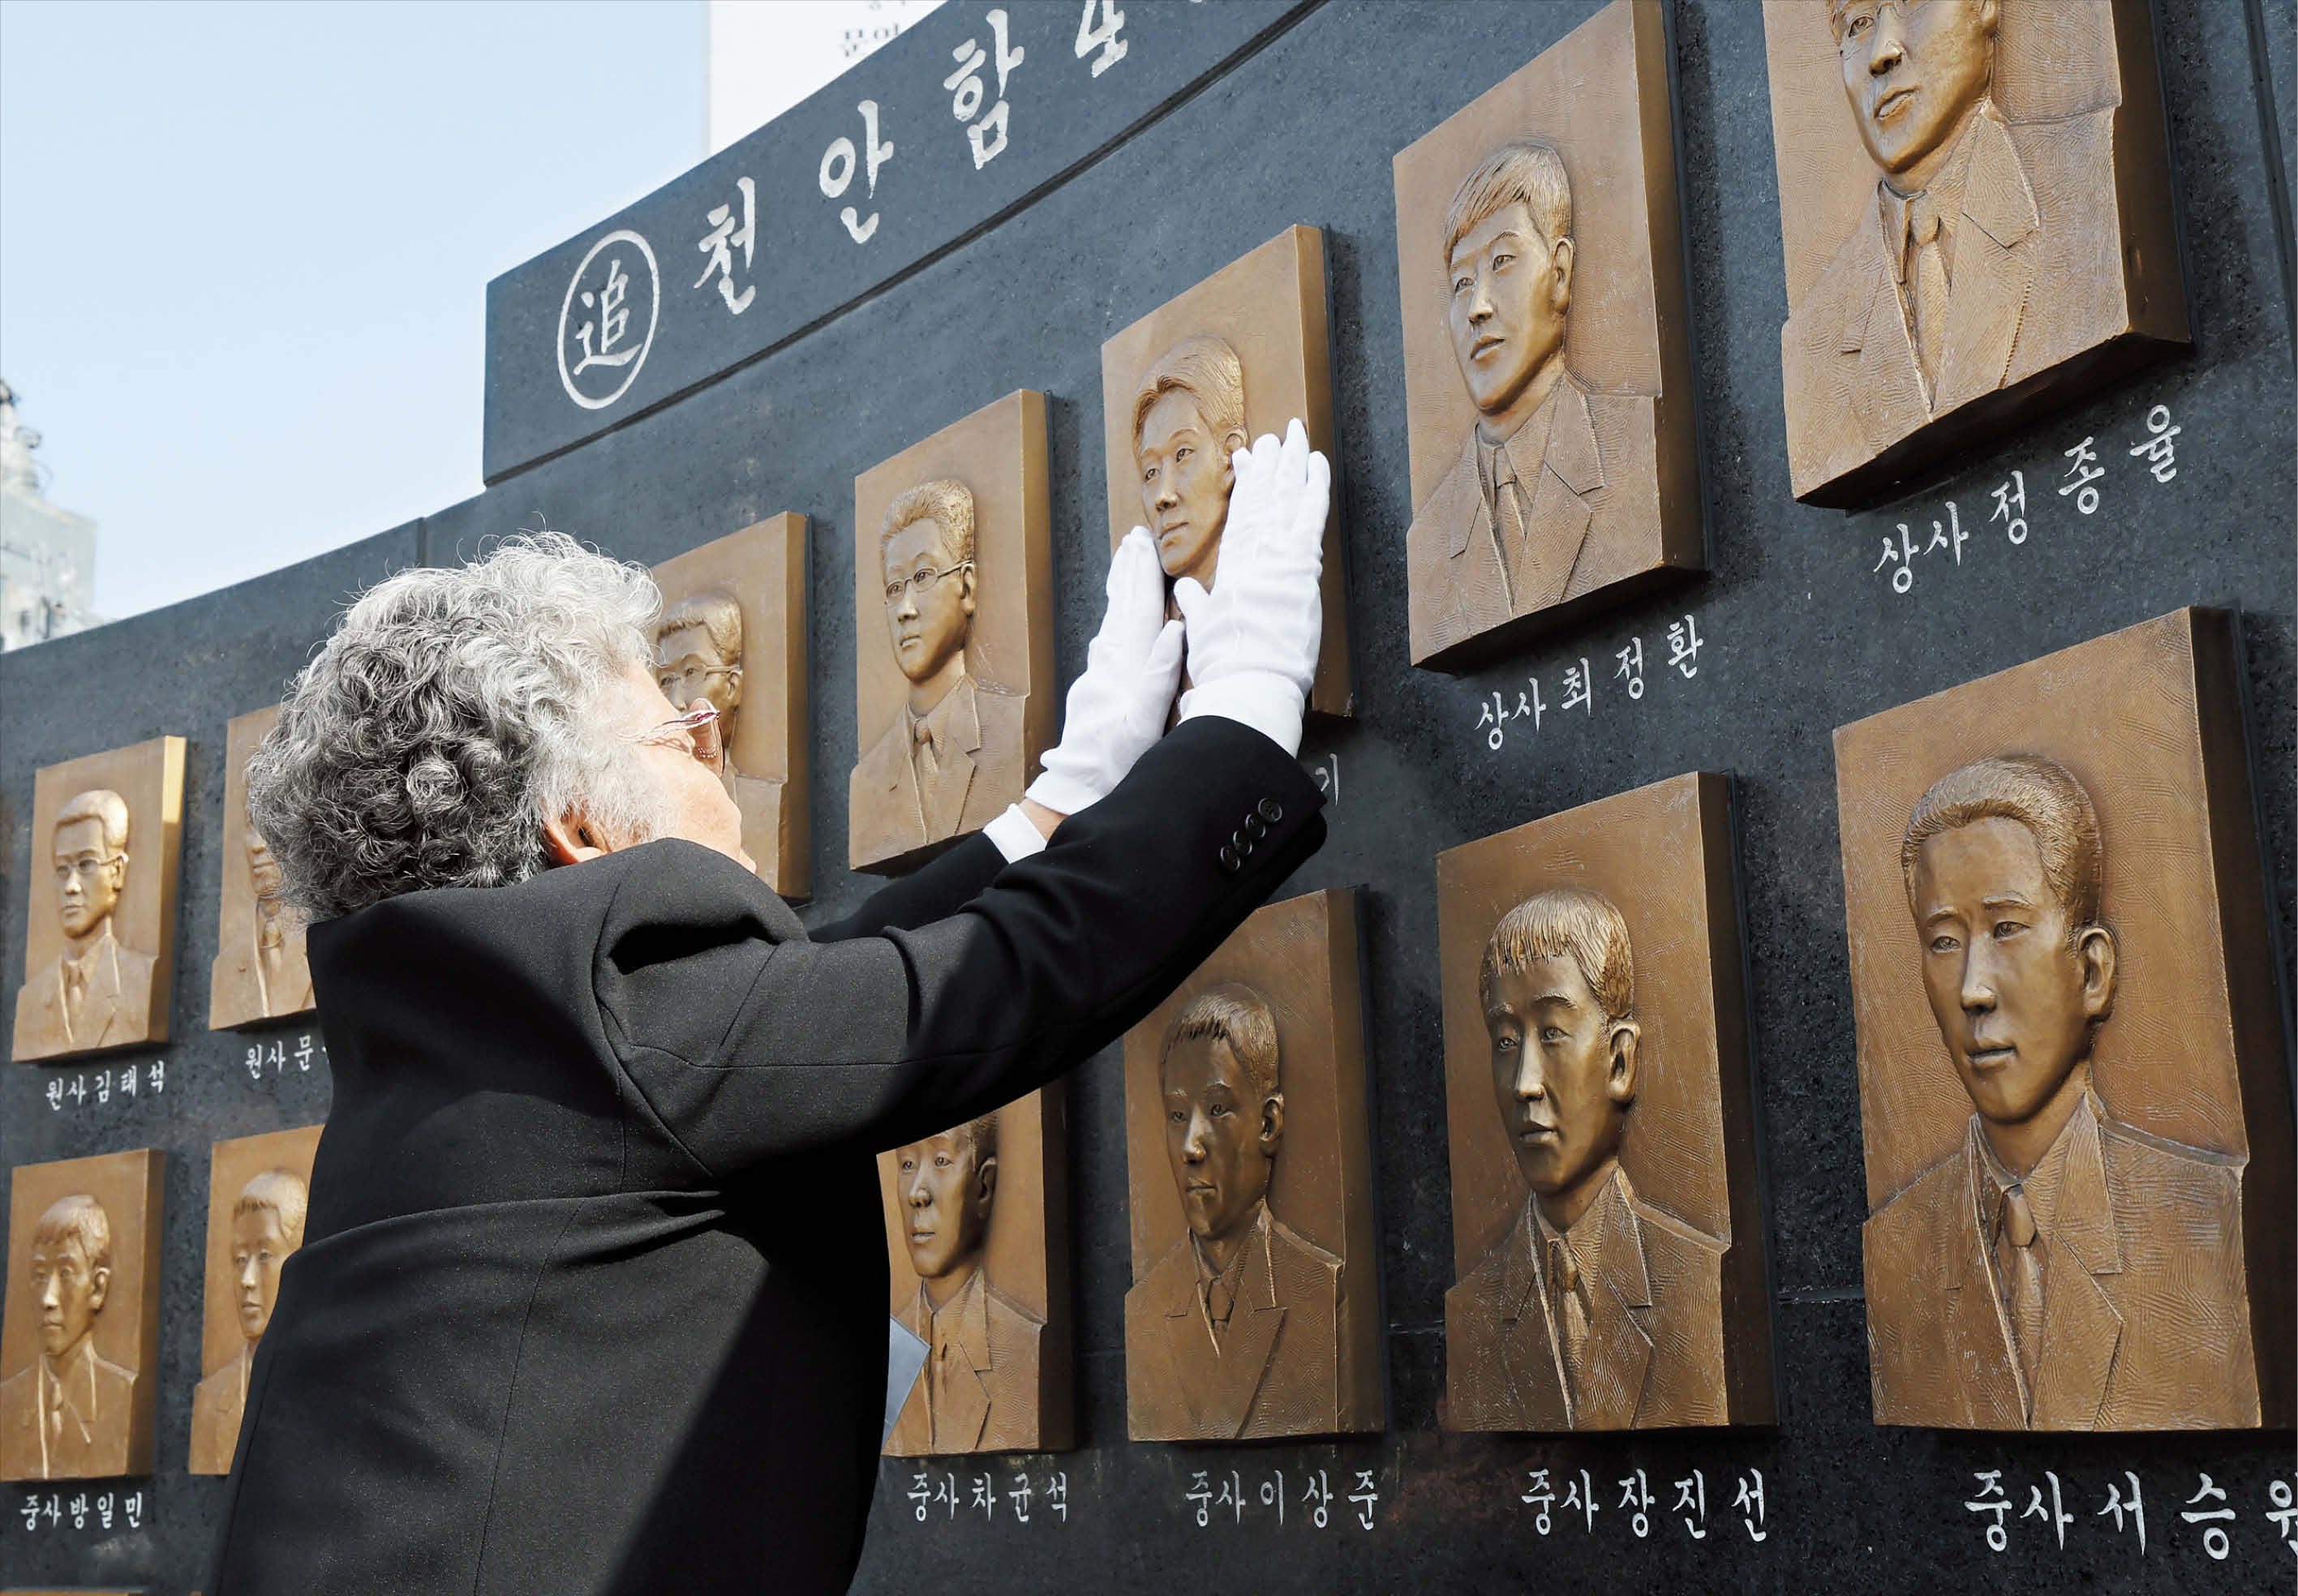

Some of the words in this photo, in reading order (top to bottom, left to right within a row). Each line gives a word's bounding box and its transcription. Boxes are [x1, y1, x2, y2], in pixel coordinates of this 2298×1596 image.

[693, 8, 1025, 315] 천안함
[1873, 501, 1969, 594] 상사
[1989, 404, 2182, 545] 정종율
[1475, 677, 1547, 750] 상사
[1561, 614, 1704, 717] 최정환
[47, 1075, 86, 1112] 원사
[95, 1061, 165, 1104] 김태석
[245, 1040, 286, 1080] 원사
[20, 1494, 62, 1531] 중사
[70, 1491, 143, 1530] 방일민
[907, 1472, 960, 1522] 중사
[972, 1471, 1067, 1523] 차균석
[1185, 1469, 1247, 1527] 중사
[1260, 1469, 1378, 1530] 이상준
[1521, 1469, 1600, 1535] 중사
[1617, 1468, 1767, 1542] 장진선
[1964, 1469, 2074, 1552] 중사
